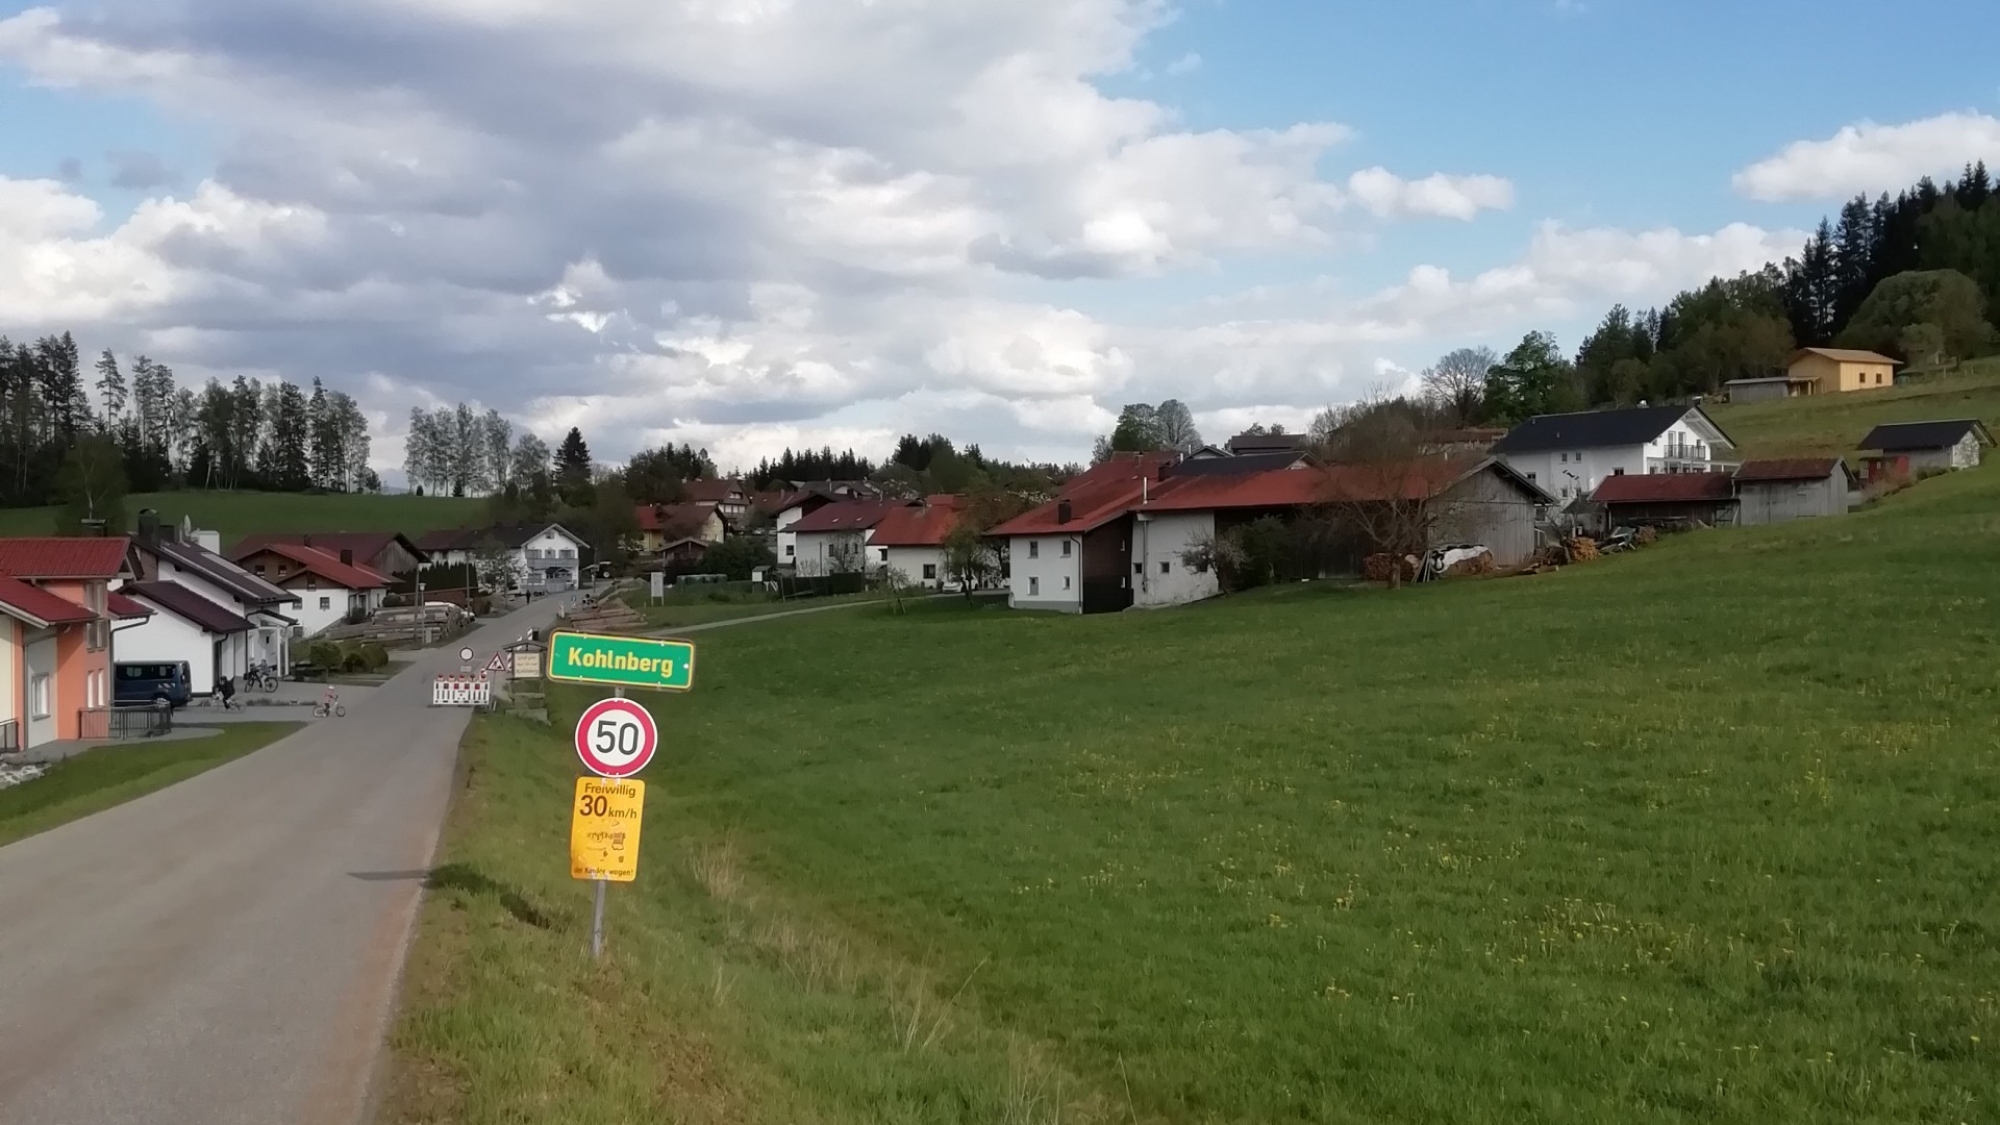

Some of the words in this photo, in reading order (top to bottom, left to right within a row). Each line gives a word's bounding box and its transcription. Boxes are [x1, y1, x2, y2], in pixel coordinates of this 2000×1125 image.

[568, 647, 673, 678] Kohlnberg
[596, 720, 639, 755] 50
[585, 783, 636, 798] Freiwillig
[579, 795, 608, 817] 30
[608, 807, 637, 819] km/h
